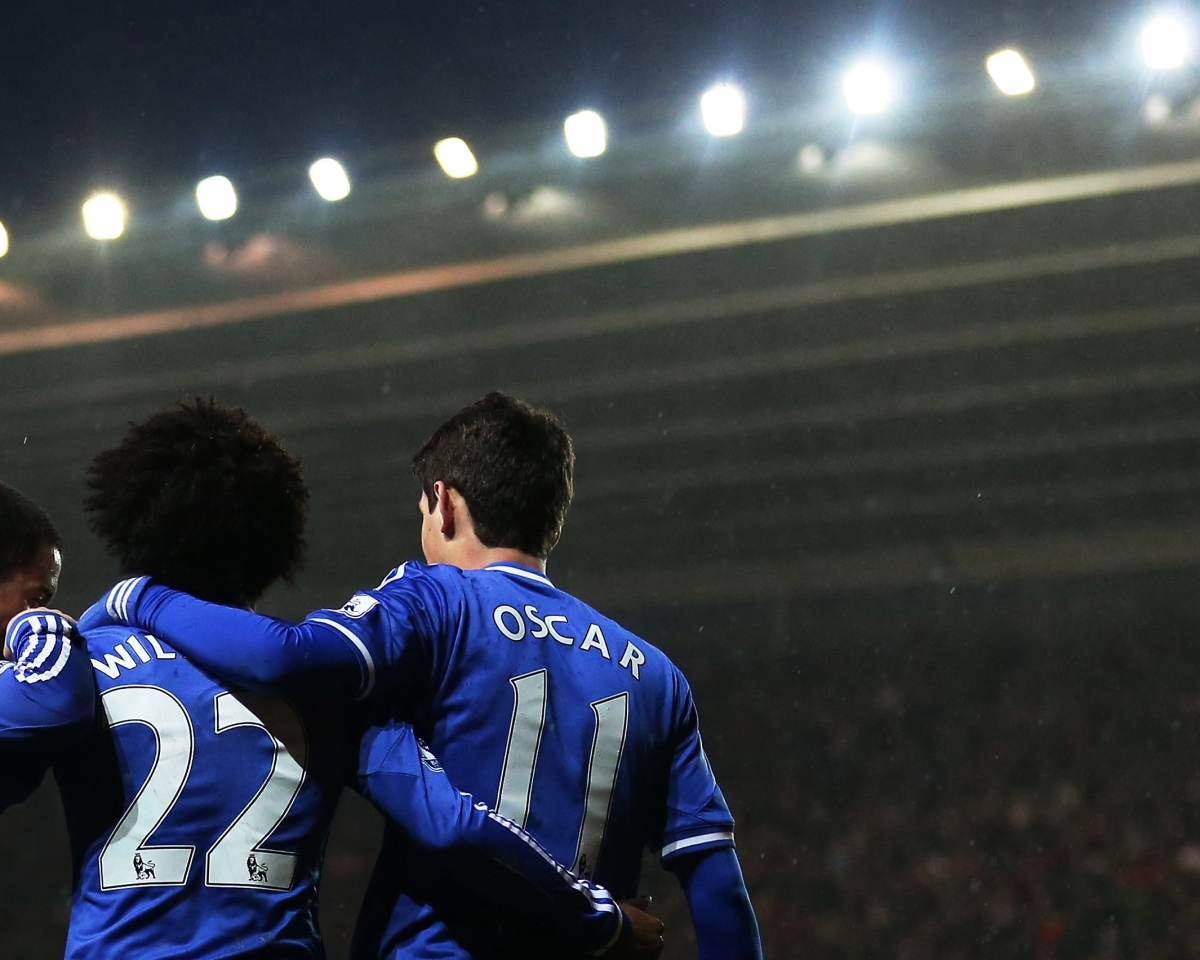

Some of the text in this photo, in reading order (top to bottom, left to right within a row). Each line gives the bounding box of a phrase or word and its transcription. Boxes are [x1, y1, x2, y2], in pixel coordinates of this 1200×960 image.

[90, 634, 180, 681] WIL
[492, 603, 647, 681] OSCAR
[99, 684, 308, 891] 22
[493, 667, 629, 883] 11
